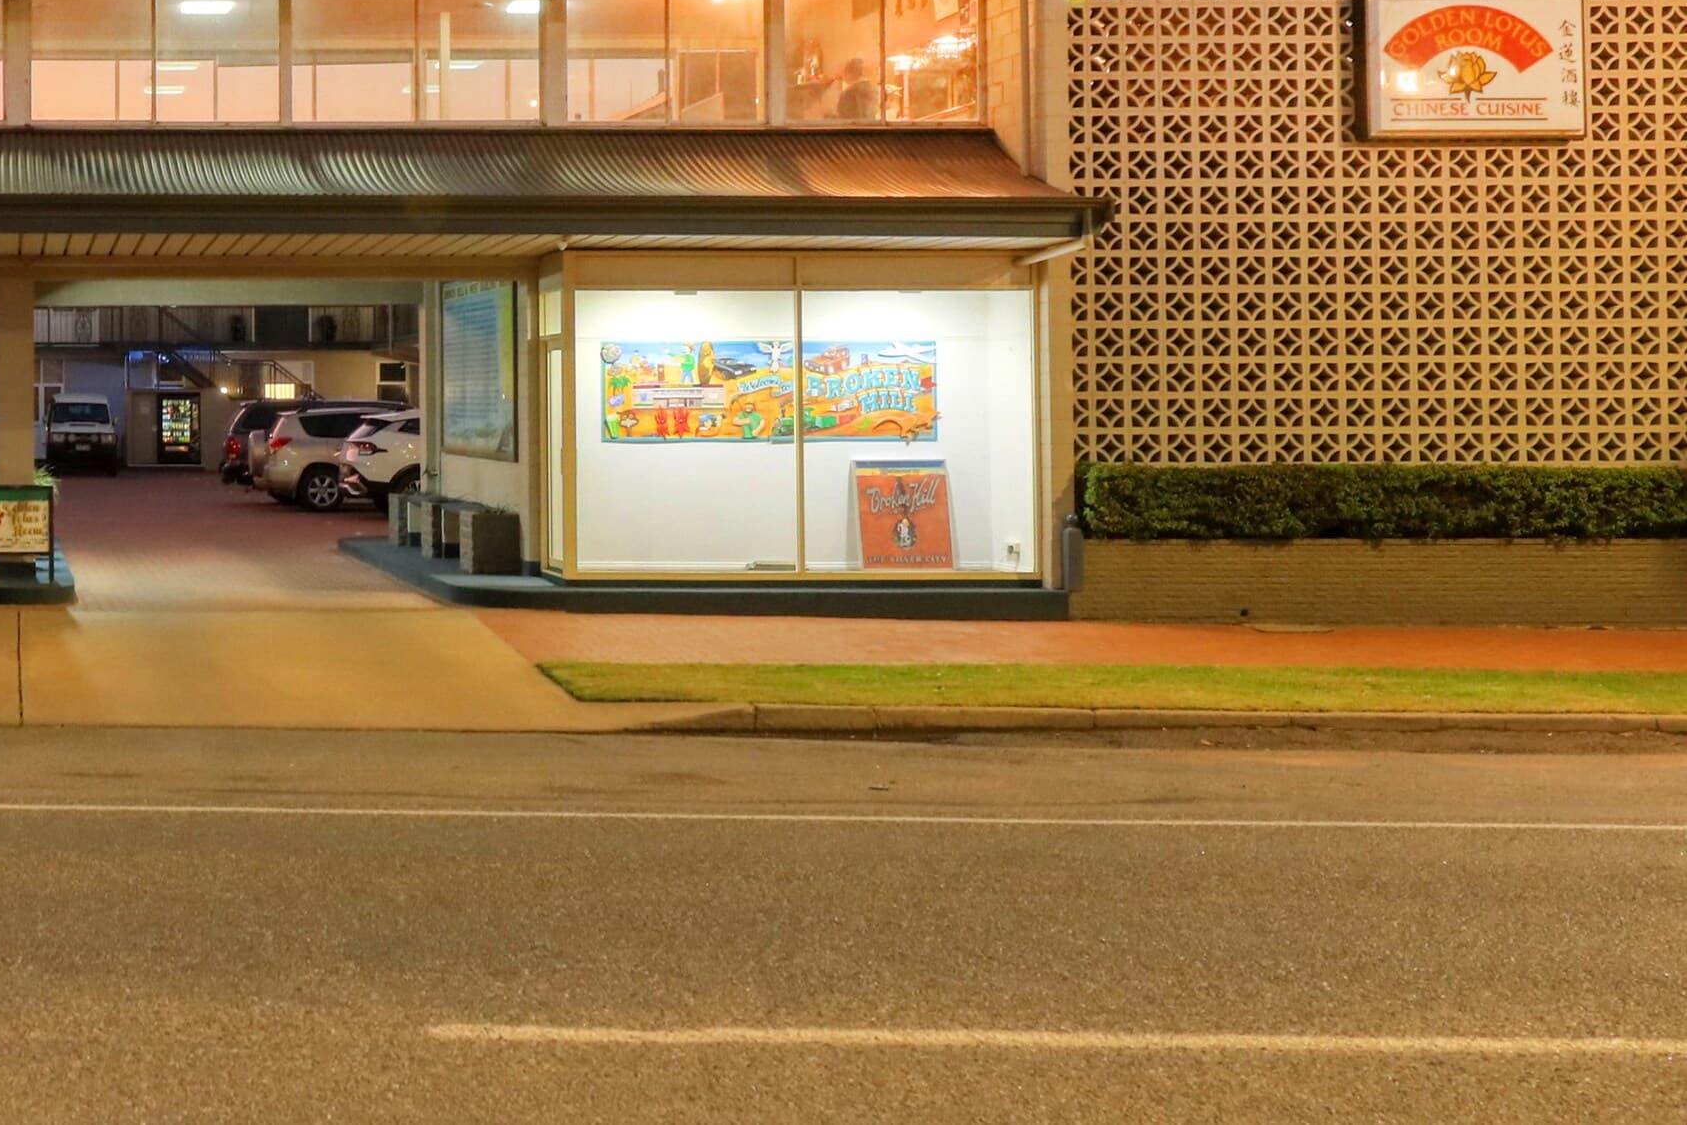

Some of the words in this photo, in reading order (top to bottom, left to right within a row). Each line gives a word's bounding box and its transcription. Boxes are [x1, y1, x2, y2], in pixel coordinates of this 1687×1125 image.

[1388, 9, 1476, 58] GOLDEN
[1484, 13, 1547, 58] LOTUS
[1434, 28, 1503, 53] ROOM
[1393, 102, 1469, 116] CHINESE
[1476, 102, 1543, 116] CUISINE
[806, 367, 921, 399] BROKEN
[859, 390, 917, 413] HILL
